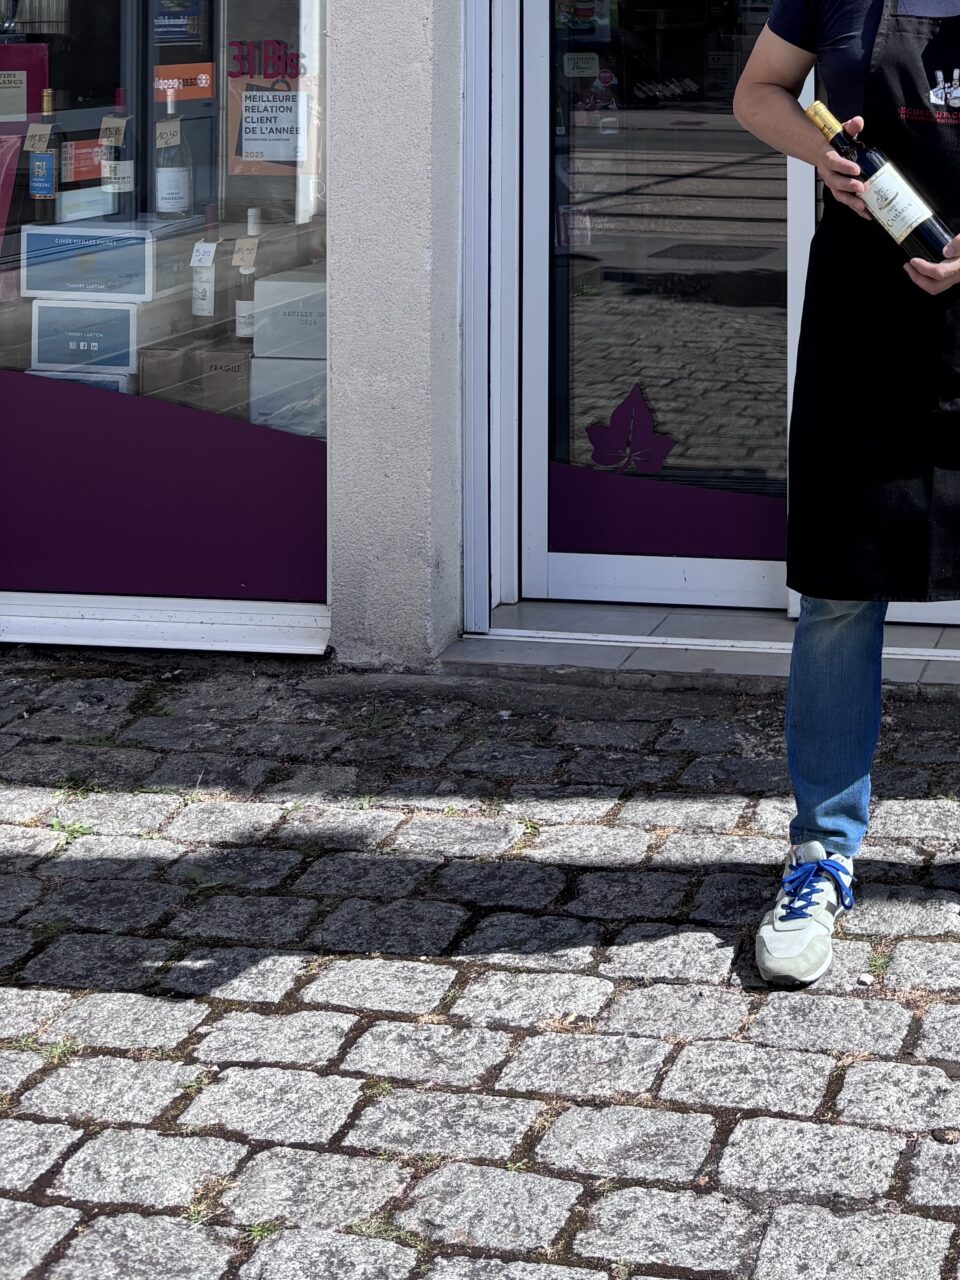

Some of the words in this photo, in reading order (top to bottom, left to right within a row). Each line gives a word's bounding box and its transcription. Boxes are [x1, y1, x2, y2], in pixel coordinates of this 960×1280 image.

[227, 40, 255, 79] 31
[263, 39, 301, 80] Bis
[244, 94, 297, 103] MEILLEURE
[244, 105, 293, 113] RELATION
[244, 116, 278, 124] CLIENT
[244, 127, 257, 135] DE
[260, 125, 301, 135] L'ANNÉE
[209, 364, 242, 373] FRAGILE
